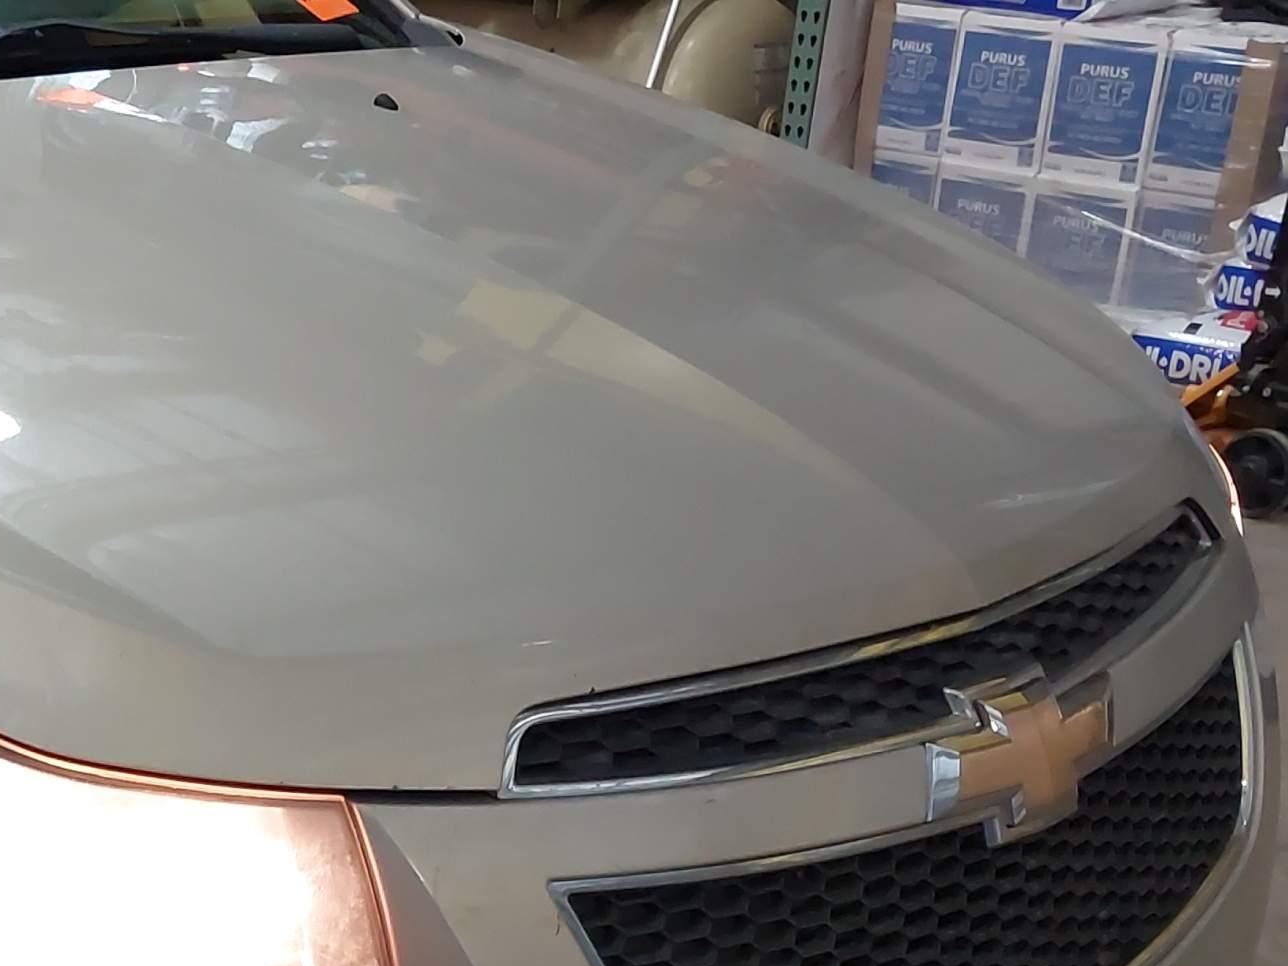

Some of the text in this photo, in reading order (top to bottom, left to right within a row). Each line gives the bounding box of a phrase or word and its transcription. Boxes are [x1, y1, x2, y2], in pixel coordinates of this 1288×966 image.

[892, 38, 934, 55] PURUS
[980, 50, 1027, 67] PURUS
[968, 62, 1030, 93] DEF
[1080, 63, 1130, 80] PURUS
[1067, 75, 1134, 107] DEF
[957, 199, 1001, 216] PURUS
